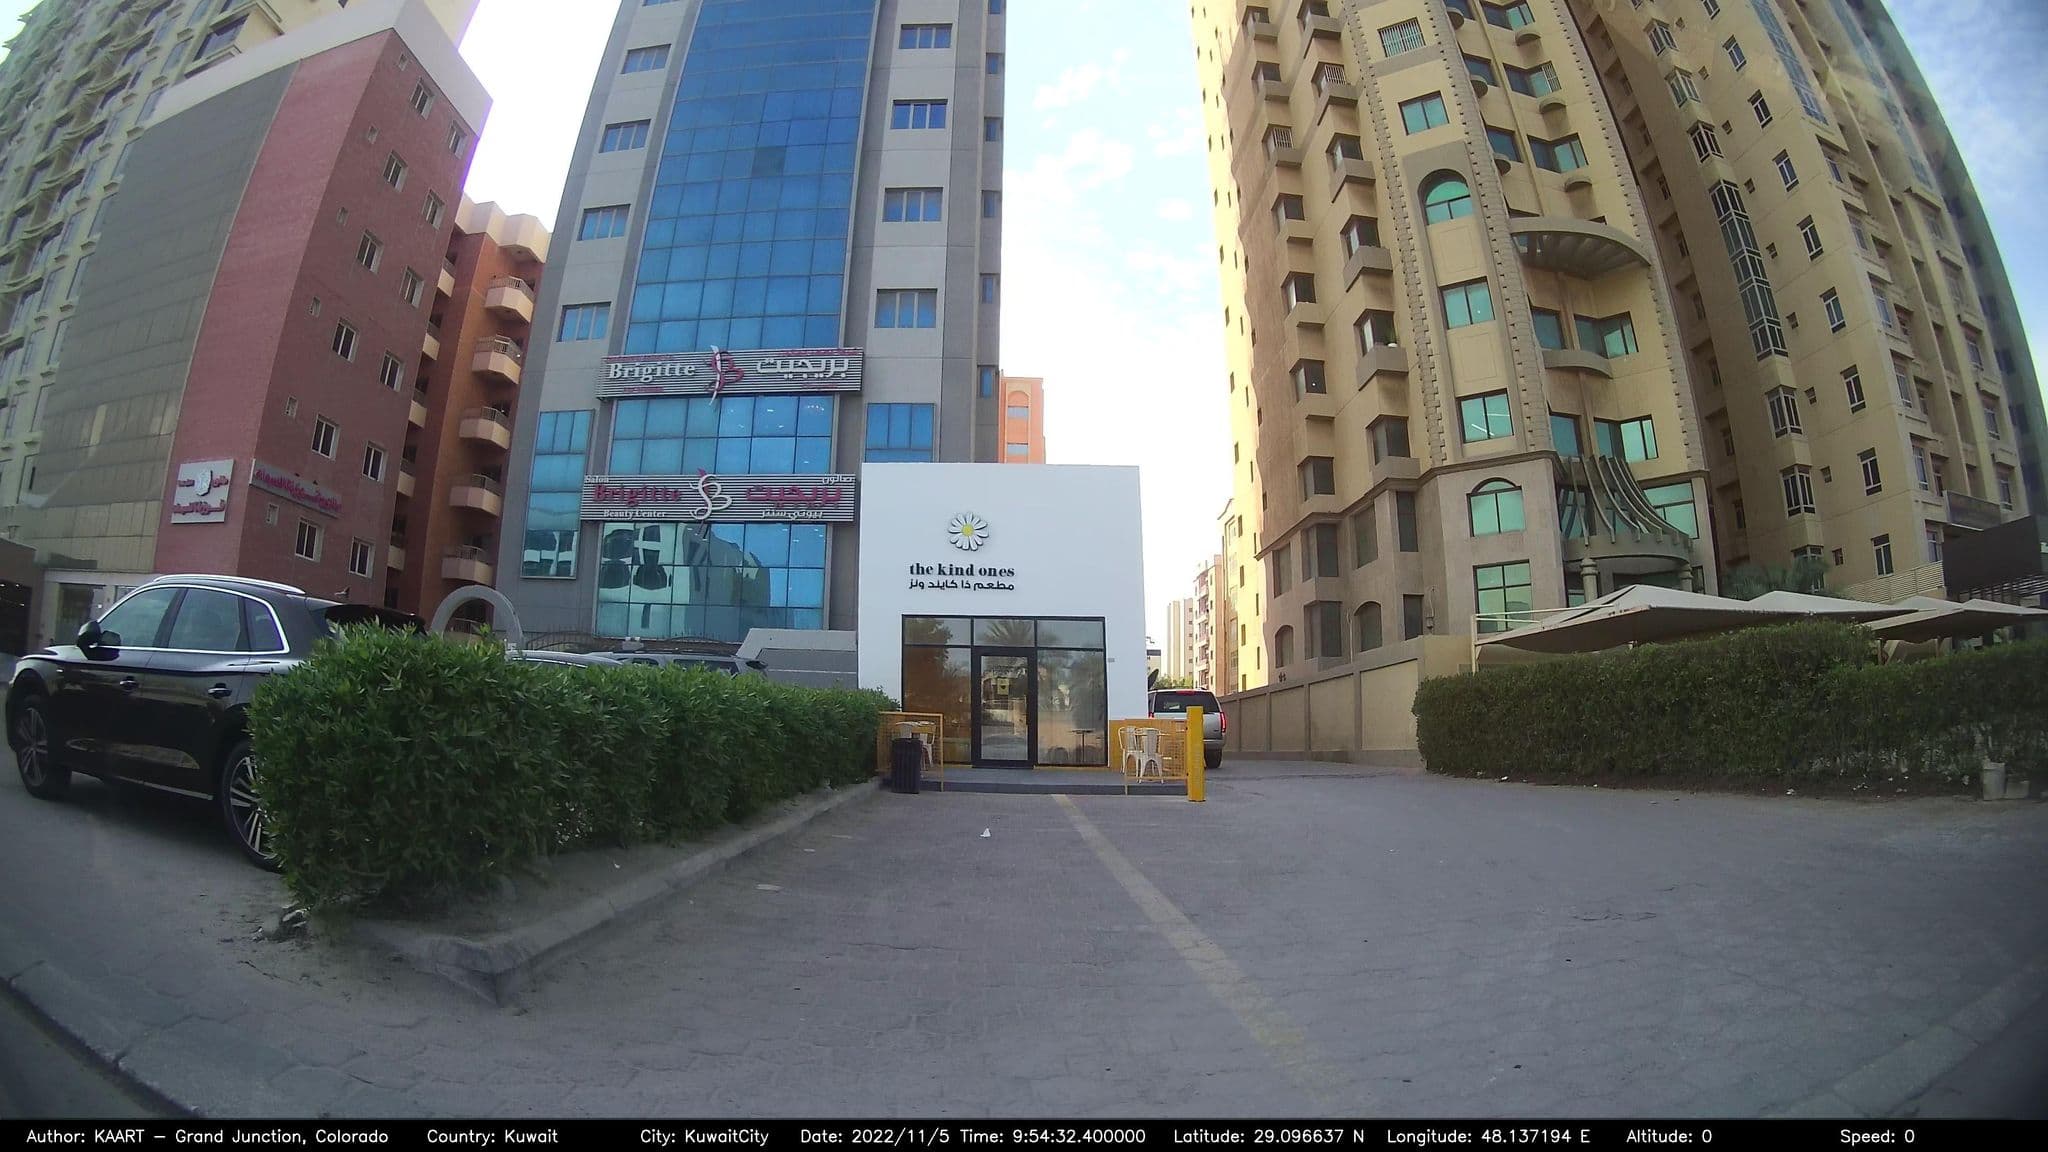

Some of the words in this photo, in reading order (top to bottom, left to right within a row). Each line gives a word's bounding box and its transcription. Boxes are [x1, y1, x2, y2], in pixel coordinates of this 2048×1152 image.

[607, 361, 696, 383] Brigitte
[756, 356, 850, 379] بريجيت
[584, 475, 609, 483] Salon
[822, 474, 854, 484] صالون
[593, 484, 682, 507] Brigitte
[746, 485, 842, 509] بريجيت
[603, 509, 634, 519] Beauty
[635, 510, 666, 518] Center
[909, 562, 934, 576] the
[937, 563, 975, 577] kind
[978, 567, 1015, 577] ones
[908, 578, 925, 590] ونز
[927, 579, 958, 591] كايند
[961, 579, 971, 589] ذا
[973, 580, 1015, 592] مطعم
